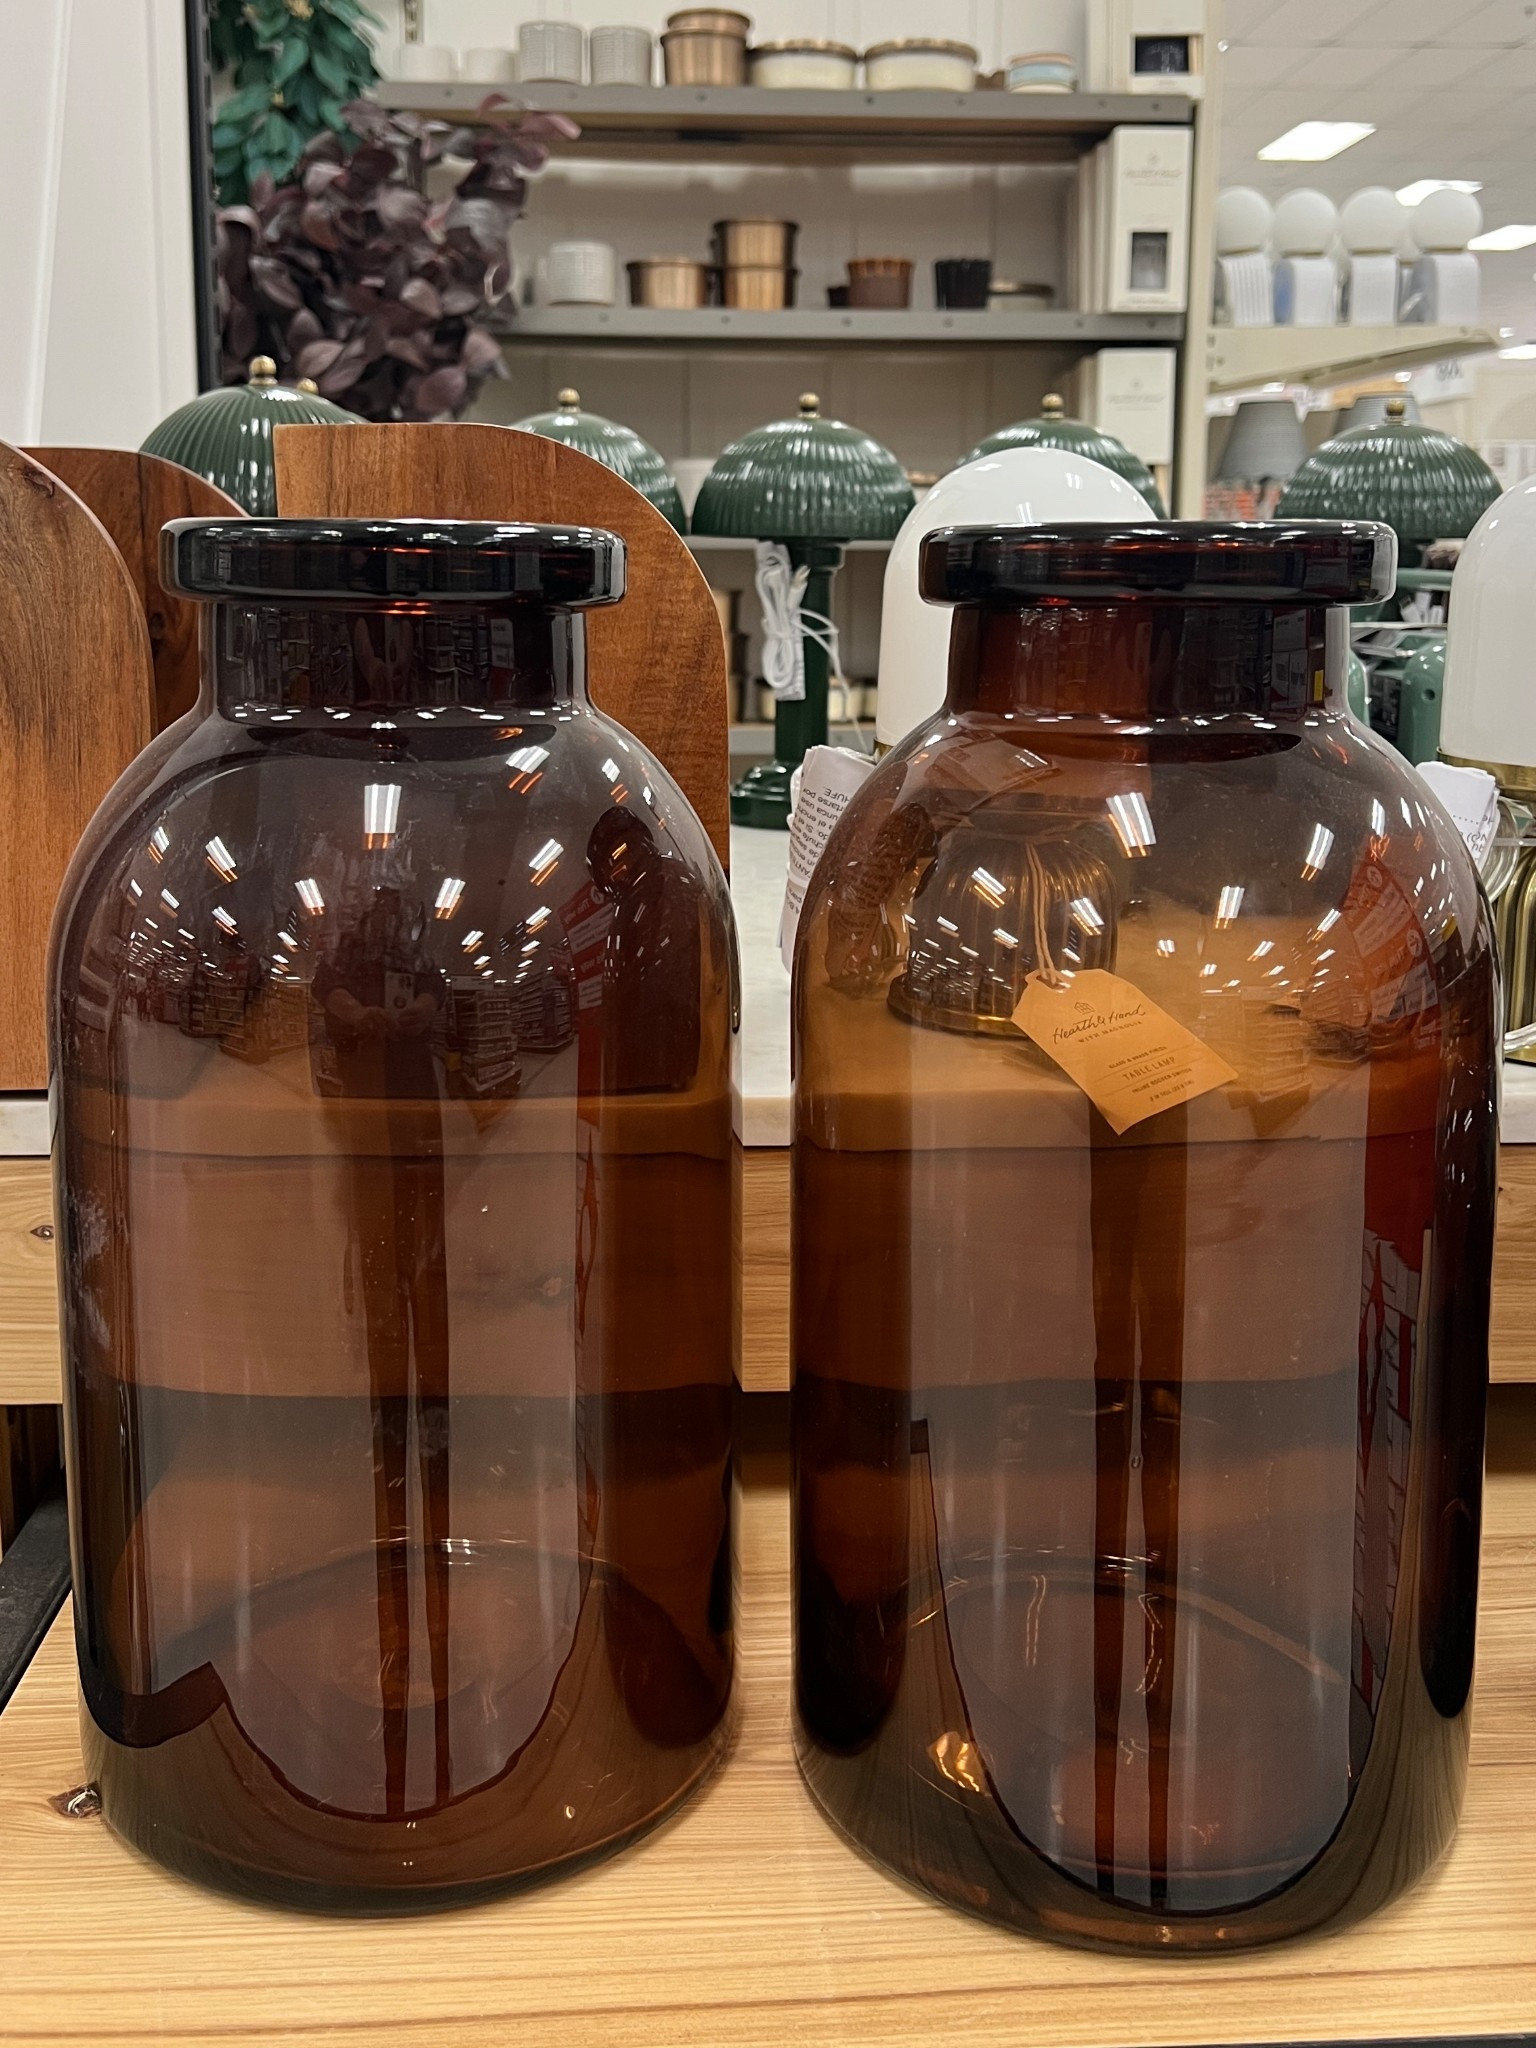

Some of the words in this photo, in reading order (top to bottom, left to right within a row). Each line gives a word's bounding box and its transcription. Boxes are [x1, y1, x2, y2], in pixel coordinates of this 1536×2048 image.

[817, 796, 844, 811] rtarse
[817, 807, 839, 821] unca
[802, 832, 824, 848] chufe
[1052, 1015, 1098, 1045] Hearth
[1097, 1015, 1106, 1026] &
[1108, 1003, 1147, 1024] Hand
[1078, 1033, 1100, 1043] WITH
[1102, 1021, 1143, 1035] MAGNOLIA
[1123, 1065, 1152, 1081] TABLE
[1152, 1056, 1176, 1070] LAMP
